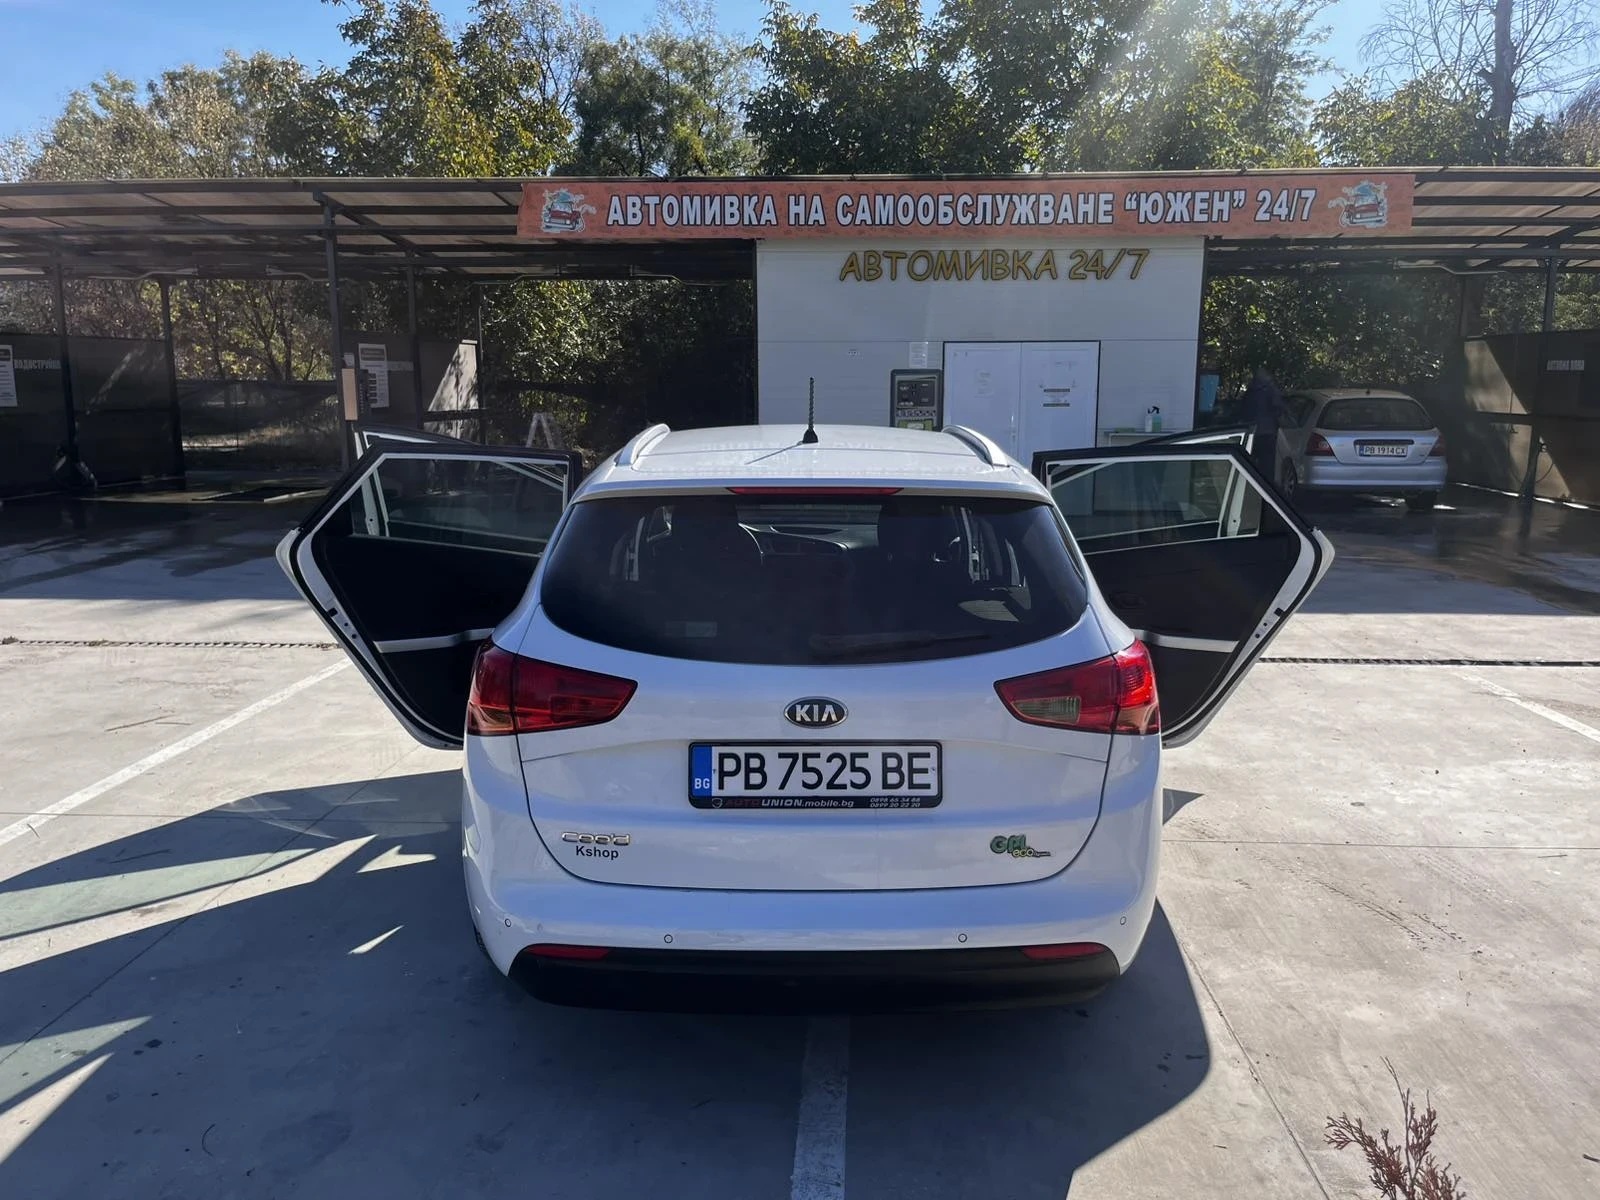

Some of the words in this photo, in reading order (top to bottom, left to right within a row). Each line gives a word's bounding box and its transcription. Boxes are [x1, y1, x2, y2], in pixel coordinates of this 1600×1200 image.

[607, 194, 778, 226] АВТОМИВКА
[788, 194, 825, 226] НА
[836, 192, 1114, 226] САМООБСЛУЖВАНЕ
[1254, 188, 1316, 222] 24/7
[839, 249, 1057, 281] АВТОМИВКА
[1068, 248, 1150, 281] 24/7
[795, 704, 838, 722] KIA
[694, 778, 711, 789] BG
[718, 752, 768, 790] PB
[777, 752, 872, 790] 7525
[881, 752, 931, 790] BE
[575, 845, 619, 860] Kshop
